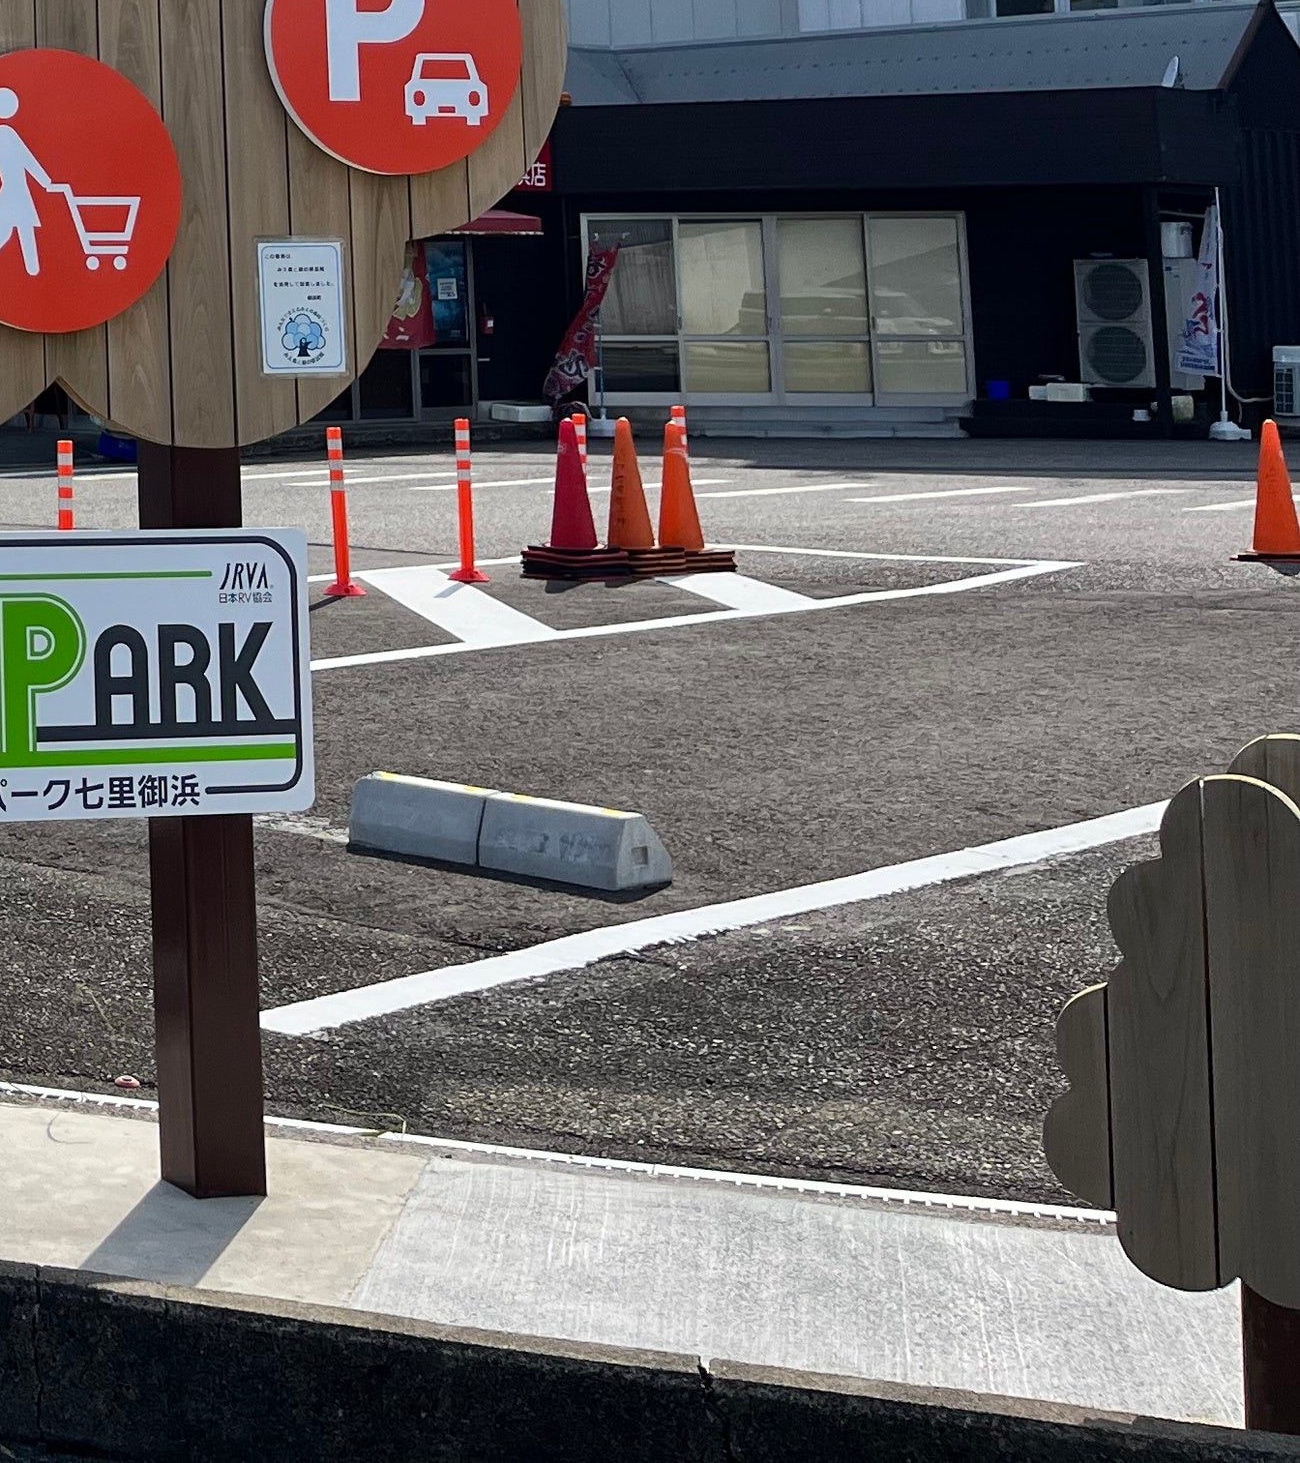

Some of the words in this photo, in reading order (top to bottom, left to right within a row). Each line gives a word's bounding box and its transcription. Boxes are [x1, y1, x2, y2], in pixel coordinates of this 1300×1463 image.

[219, 562, 268, 590] JRVA
[219, 591, 273, 604] 日本RV協会
